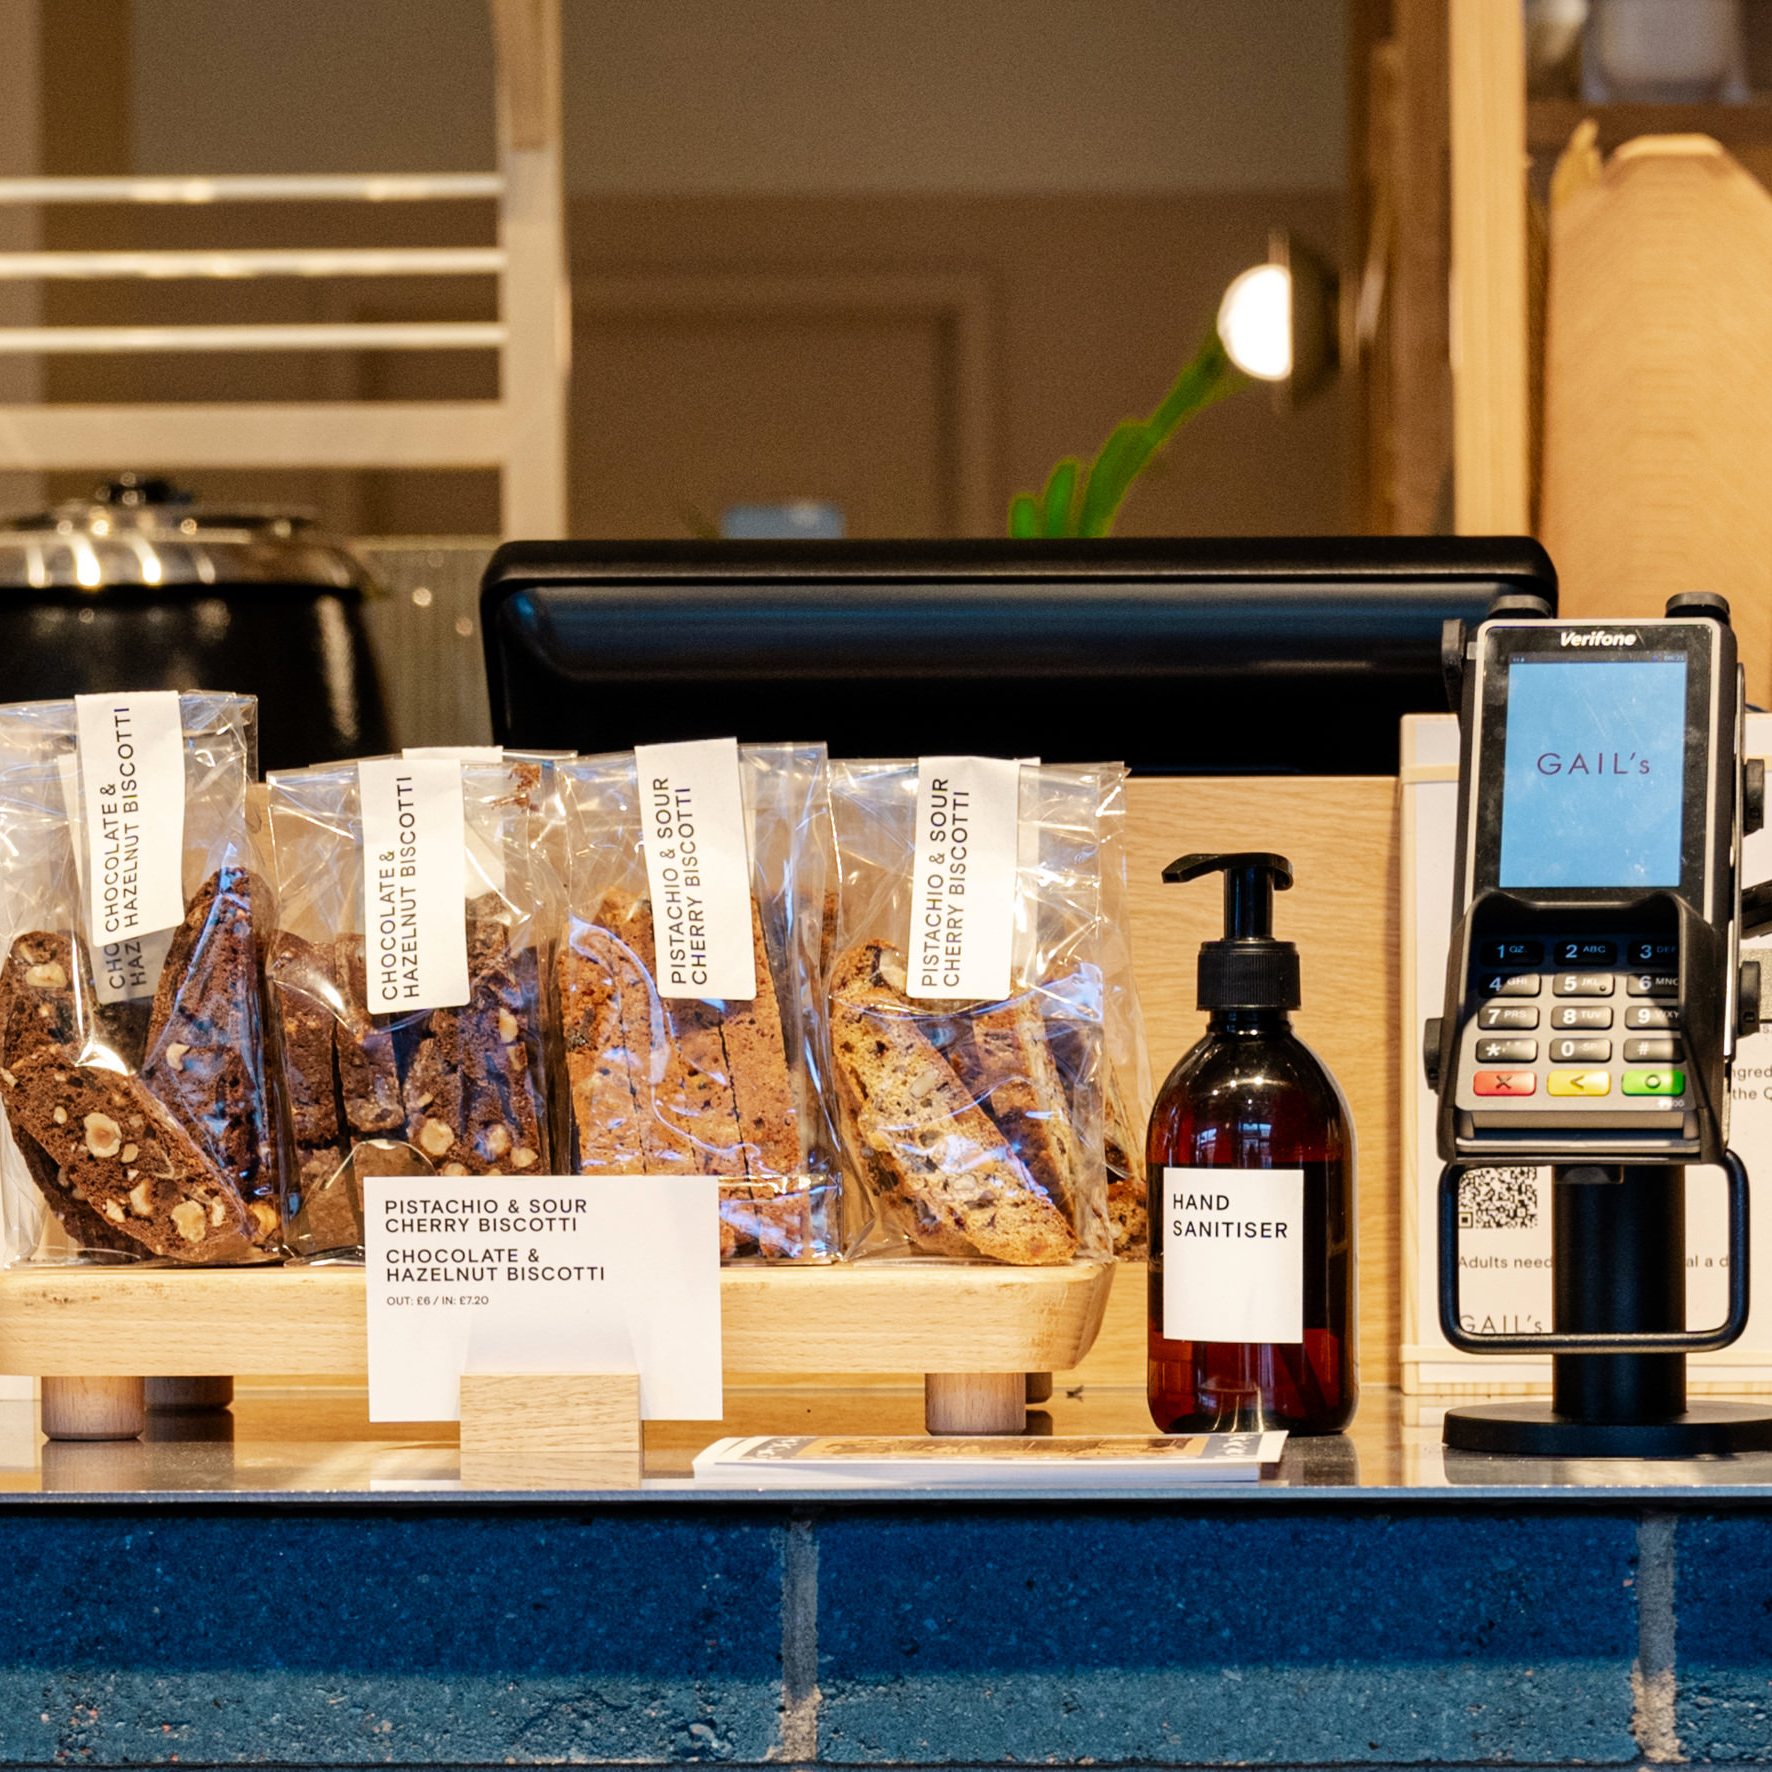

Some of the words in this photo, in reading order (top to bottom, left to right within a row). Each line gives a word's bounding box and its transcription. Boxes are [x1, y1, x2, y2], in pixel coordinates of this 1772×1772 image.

[1560, 631, 1637, 647] Verifone
[114, 707, 139, 814] BISCOTTI
[1537, 752, 1650, 775] GAIL's
[100, 784, 116, 796] &
[653, 777, 674, 839] SOUR
[929, 778, 949, 842] SOUR
[396, 777, 416, 878] BISCOTTI
[675, 788, 701, 887] BISCOTTI
[949, 791, 970, 895] BISCOTTI
[379, 850, 395, 862] &
[659, 848, 675, 859] &
[929, 853, 945, 864] &
[102, 803, 120, 933] CHOCOLATE
[123, 823, 139, 929] HAZELNUT
[379, 867, 398, 1001] CHOCOLATE
[662, 868, 687, 985] PISTACHIO
[921, 874, 944, 987] PISTACHIO
[401, 886, 420, 999] HAZELNUT
[686, 896, 708, 985] CHERRY
[943, 904, 965, 987] CHERRY
[1496, 945, 1505, 959] 1
[1565, 945, 1578, 959] 2
[1583, 945, 1606, 953] ABC
[1639, 945, 1652, 959] 3
[1489, 977, 1502, 991] 4
[1564, 977, 1577, 991] 5
[1638, 976, 1652, 990] 6
[1488, 1010, 1501, 1024] 7
[1504, 1010, 1527, 1019] PRS
[1563, 1010, 1577, 1024] 8
[1580, 1010, 1601, 1019] TUV
[1638, 1009, 1651, 1024] 9
[1561, 1042, 1575, 1056] 0
[1732, 1087, 1757, 1100] the
[385, 1199, 499, 1214] PISTACHIO
[507, 1199, 520, 1214] &
[529, 1198, 587, 1213] SOUR
[1173, 1193, 1230, 1211] HAND
[385, 1218, 469, 1233] CHERRY
[479, 1217, 577, 1232] BISCOTTI
[1173, 1219, 1288, 1239] SANITISER
[386, 1249, 519, 1264] CHOCOLATE
[527, 1248, 540, 1263] &
[1459, 1256, 1508, 1269] Adults
[387, 1267, 498, 1282] HAZELNUT
[507, 1266, 605, 1281] BISCOTTI
[386, 1296, 414, 1305] OUT:
[416, 1296, 431, 1305] £6
[432, 1296, 440, 1305] /
[442, 1296, 457, 1305] IN:
[459, 1295, 489, 1305] £7.20
